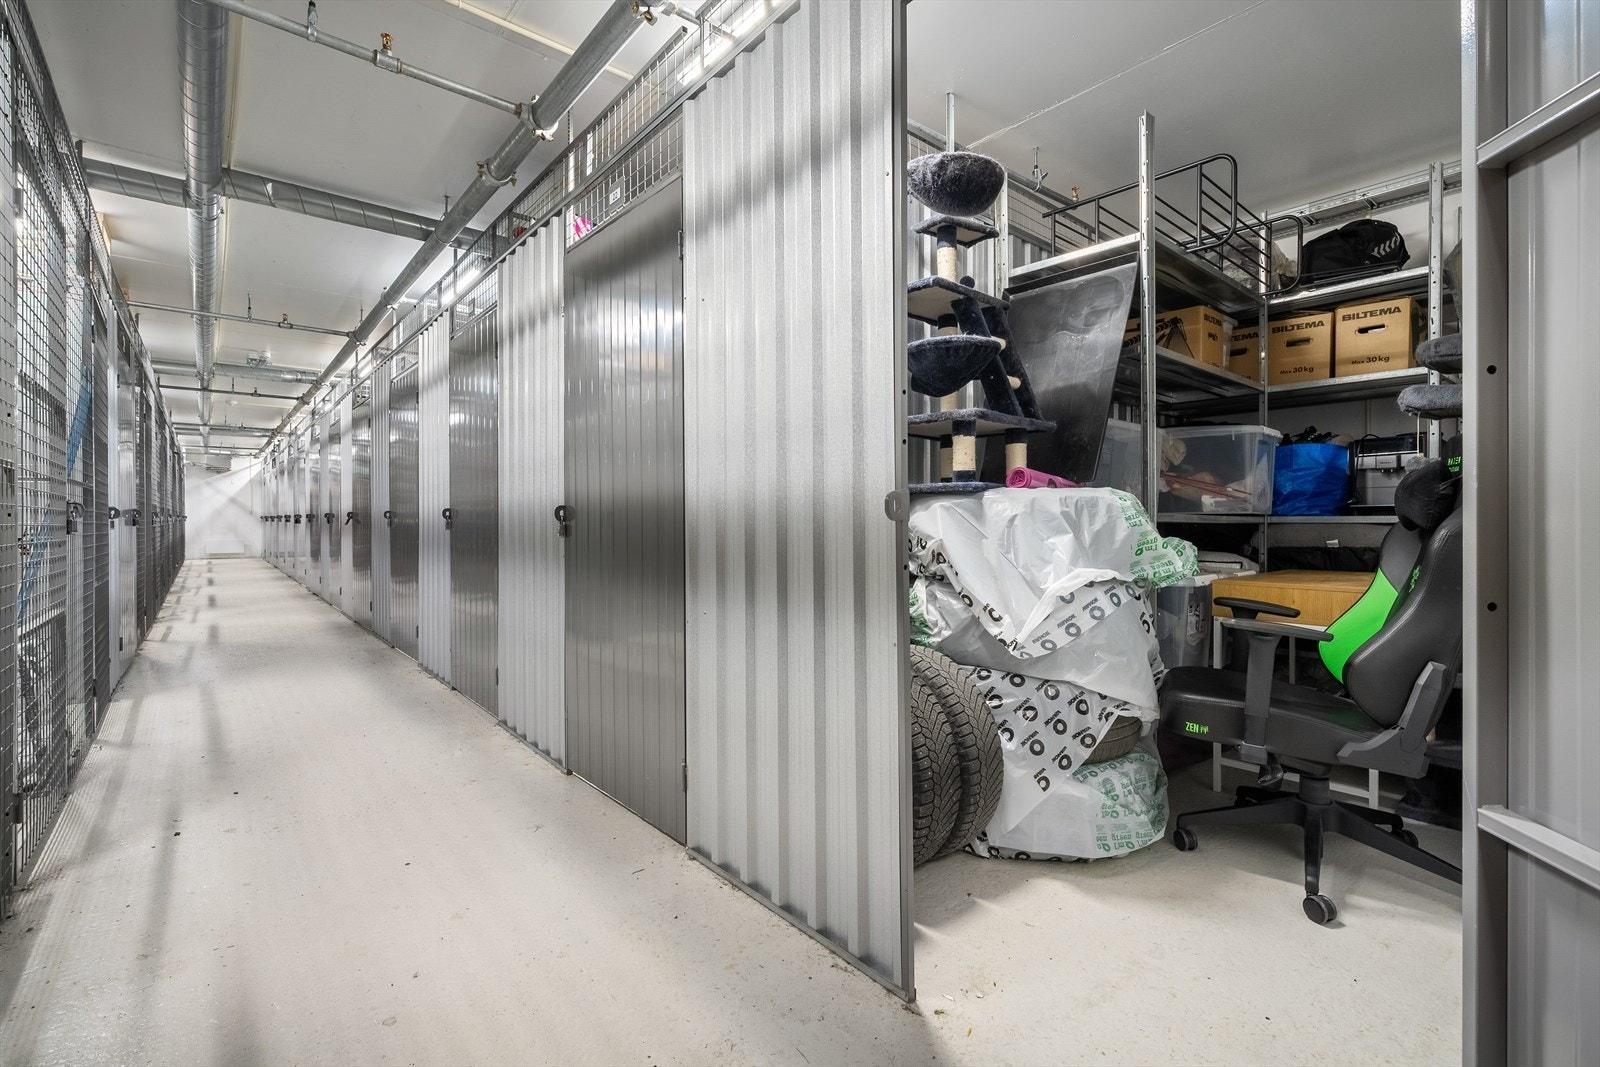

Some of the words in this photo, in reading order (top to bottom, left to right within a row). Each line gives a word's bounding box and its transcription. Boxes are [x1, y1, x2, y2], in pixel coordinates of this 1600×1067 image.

[1341, 306, 1402, 322] BILTEMA
[1271, 320, 1325, 334] BILTEMA
[1378, 355, 1390, 363] kg
[1185, 721, 1199, 733] ZEN
